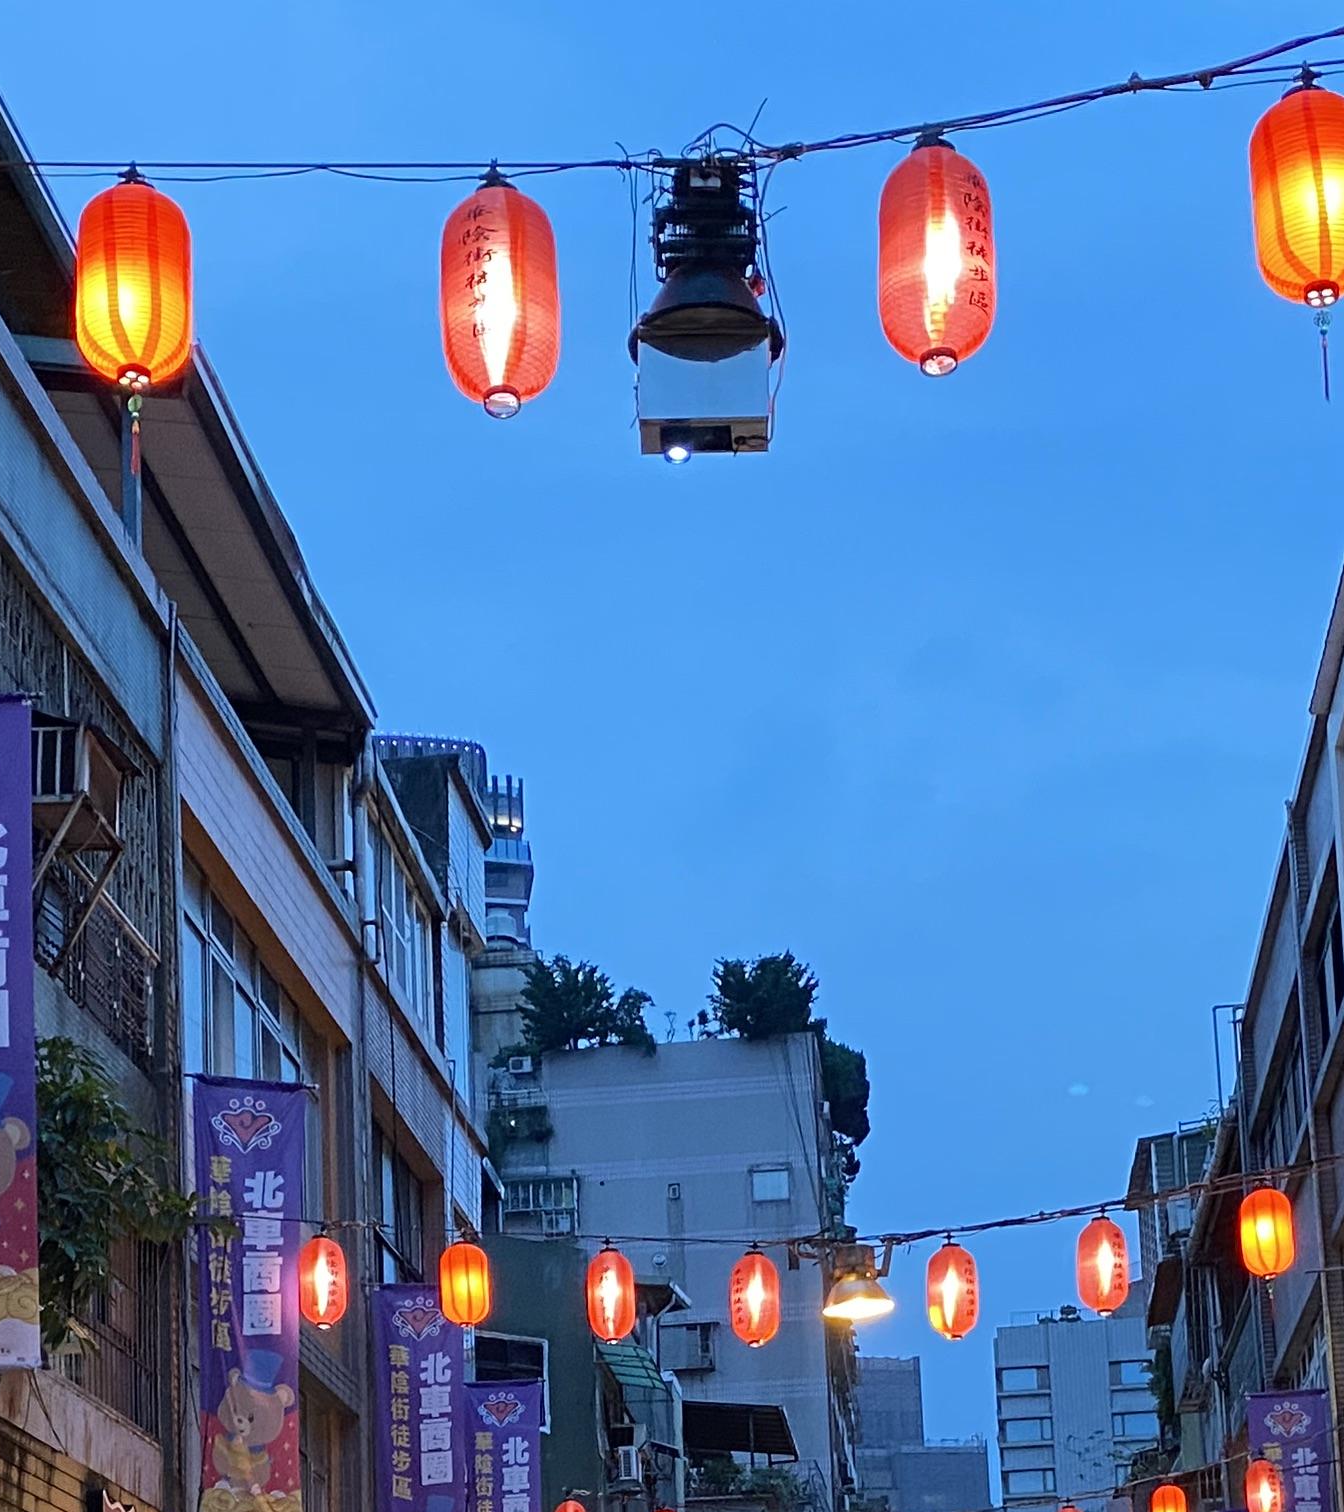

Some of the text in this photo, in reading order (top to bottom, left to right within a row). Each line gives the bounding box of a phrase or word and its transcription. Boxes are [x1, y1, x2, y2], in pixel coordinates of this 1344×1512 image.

[242, 1170, 285, 1336] 北車商圈
[388, 1344, 414, 1501] 華陰街徒步區
[419, 1352, 454, 1487] 北車商圈
